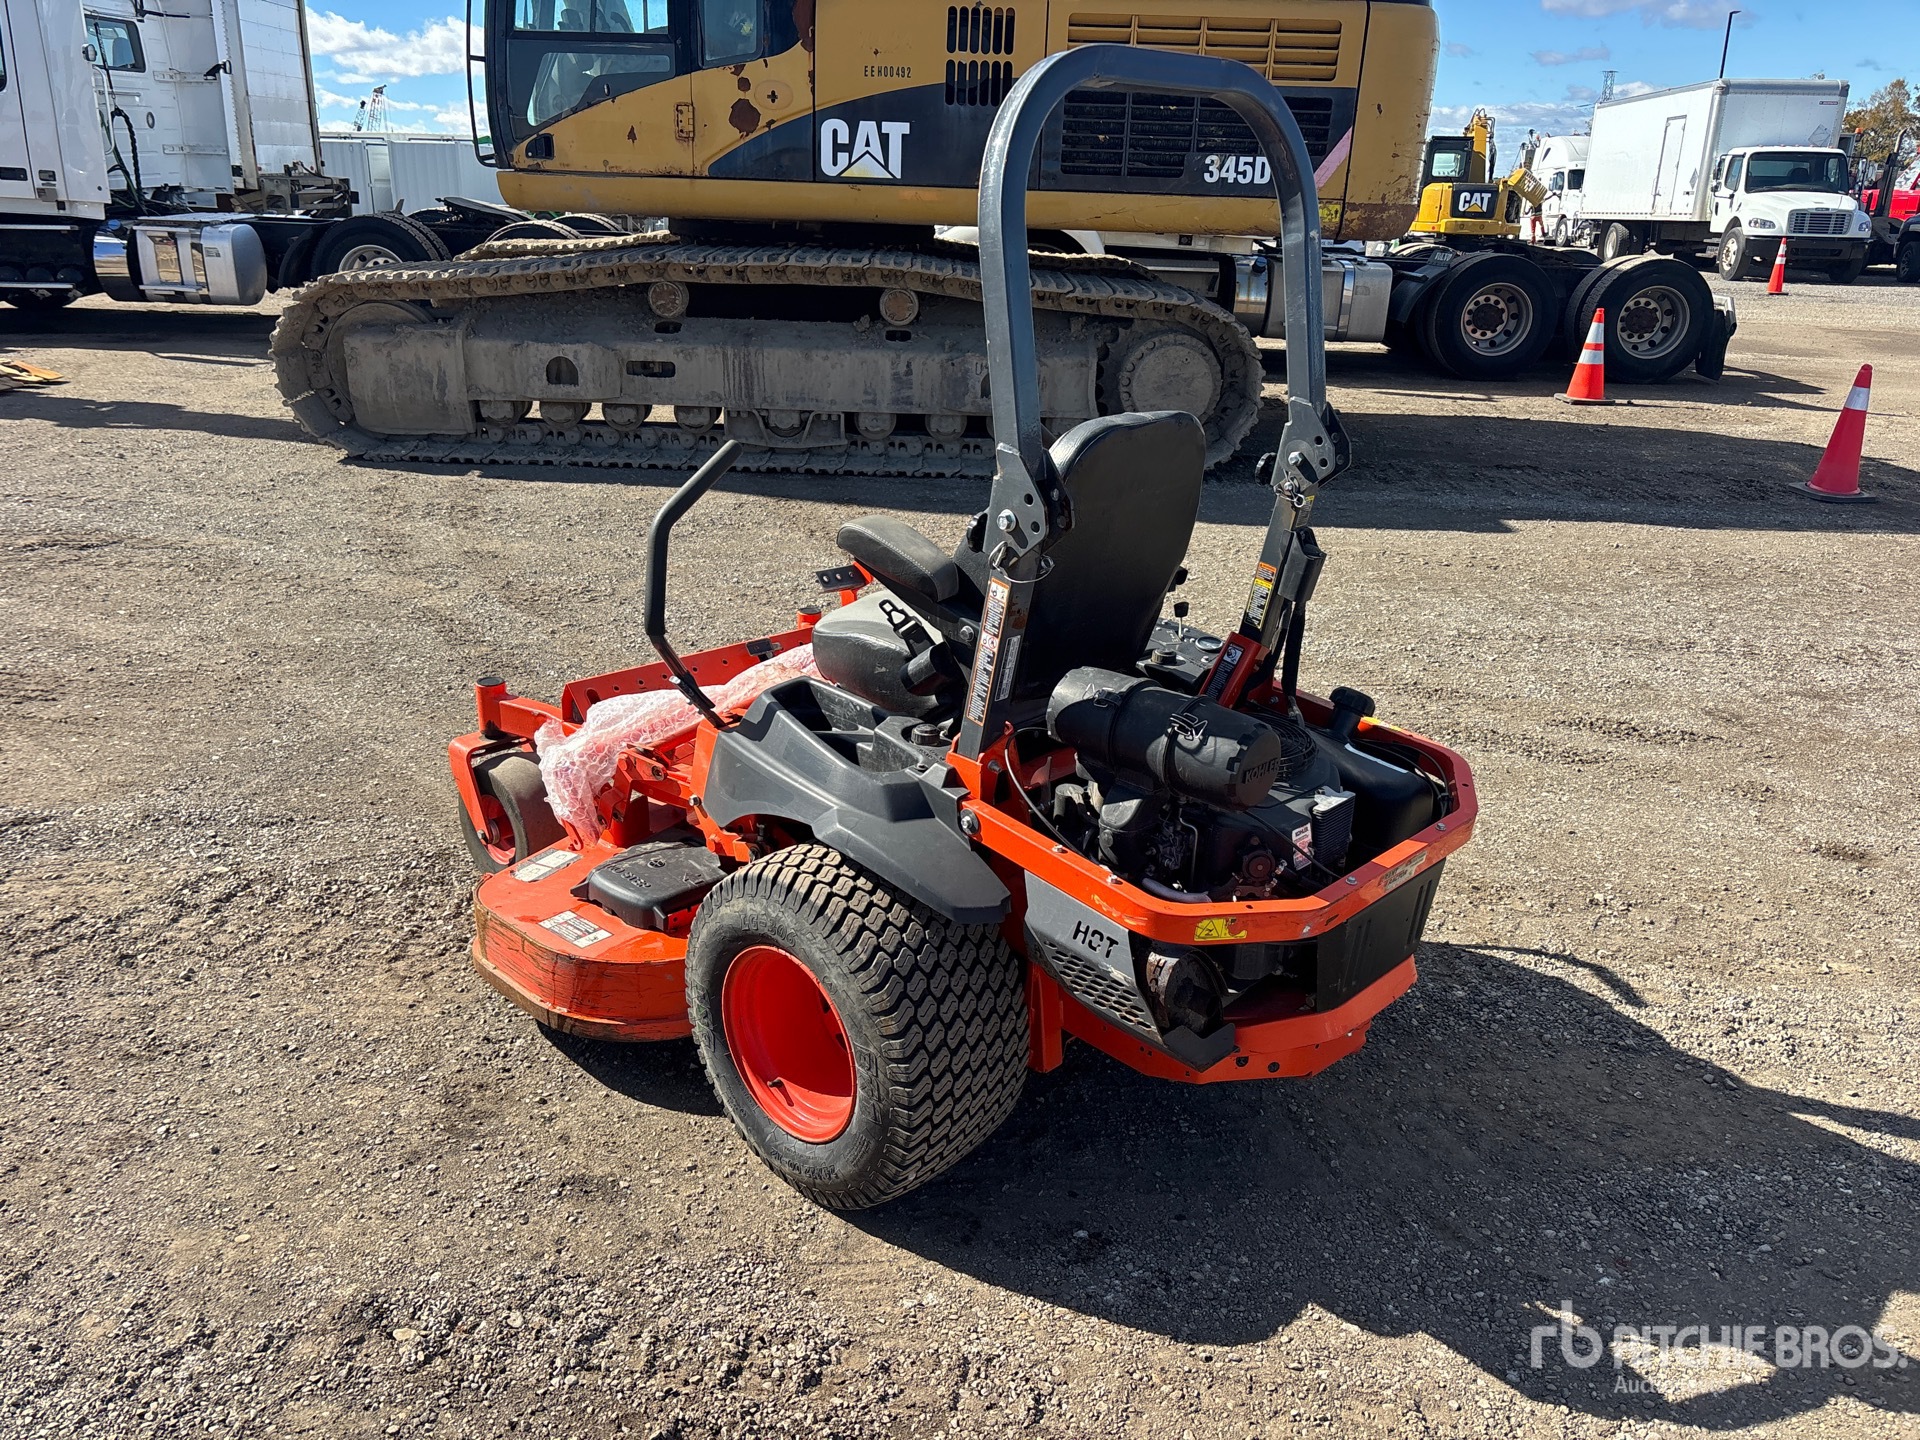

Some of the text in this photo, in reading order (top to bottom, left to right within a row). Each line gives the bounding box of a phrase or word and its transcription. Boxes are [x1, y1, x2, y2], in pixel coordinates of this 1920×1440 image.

[864, 65, 912, 78] EEH00492
[820, 118, 911, 179] CAT
[1203, 154, 1272, 185] 345D
[1458, 191, 1492, 213] CAT
[1242, 757, 1280, 784] KOHLER
[1071, 920, 1119, 958] HOT
